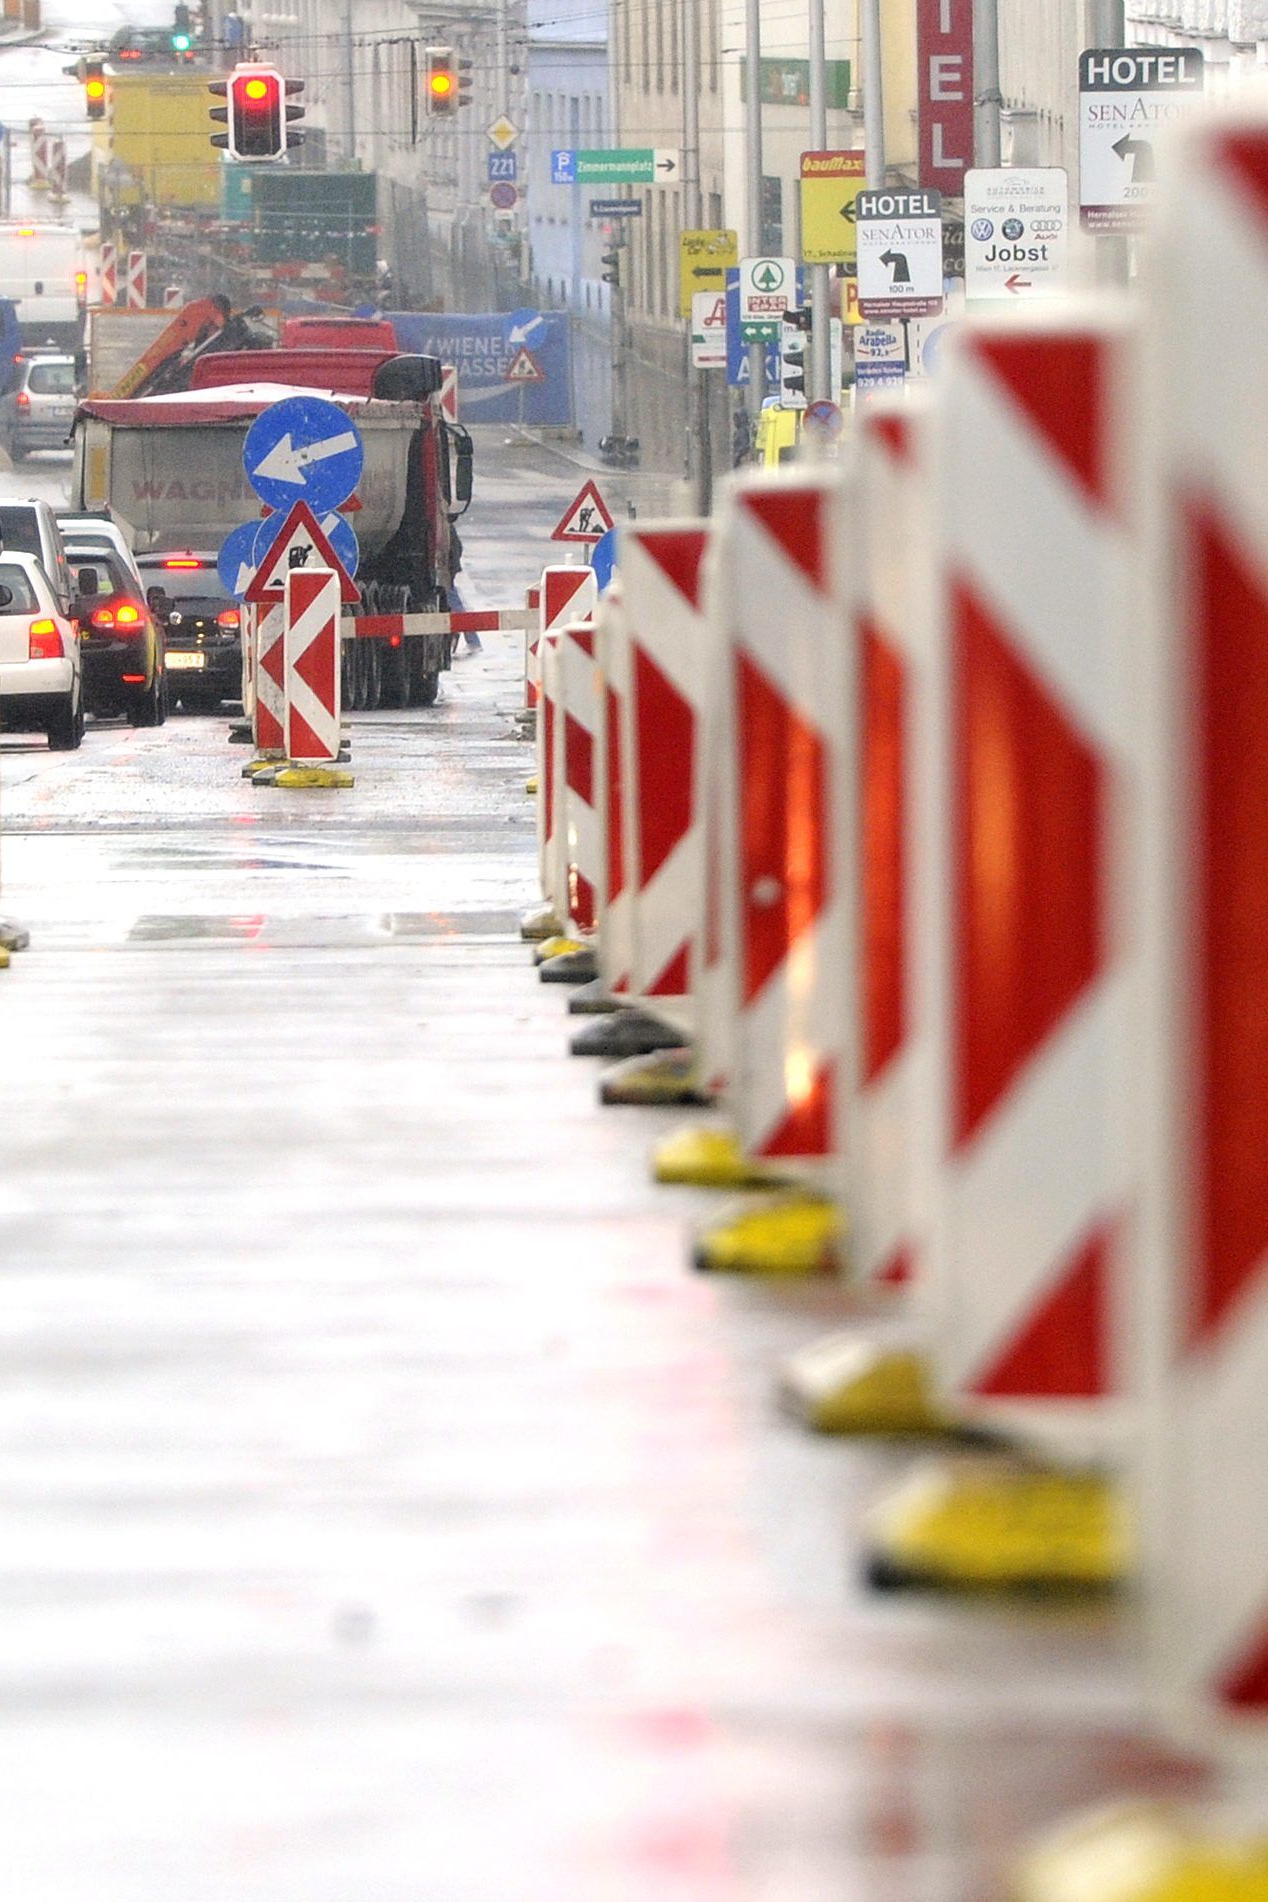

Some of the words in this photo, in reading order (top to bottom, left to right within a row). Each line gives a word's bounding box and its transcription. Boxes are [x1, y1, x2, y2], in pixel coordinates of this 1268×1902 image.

[1088, 56, 1196, 84] HOTEL
[491, 158, 515, 175] 221
[861, 195, 936, 216] HOTEL
[971, 204, 1005, 213] Service
[1008, 204, 1015, 212] &
[1020, 204, 1061, 214] Beratung
[862, 224, 936, 240] SENATOR
[985, 244, 1048, 262] Jobst
[889, 285, 905, 293] 100
[859, 335, 897, 346] Arabella
